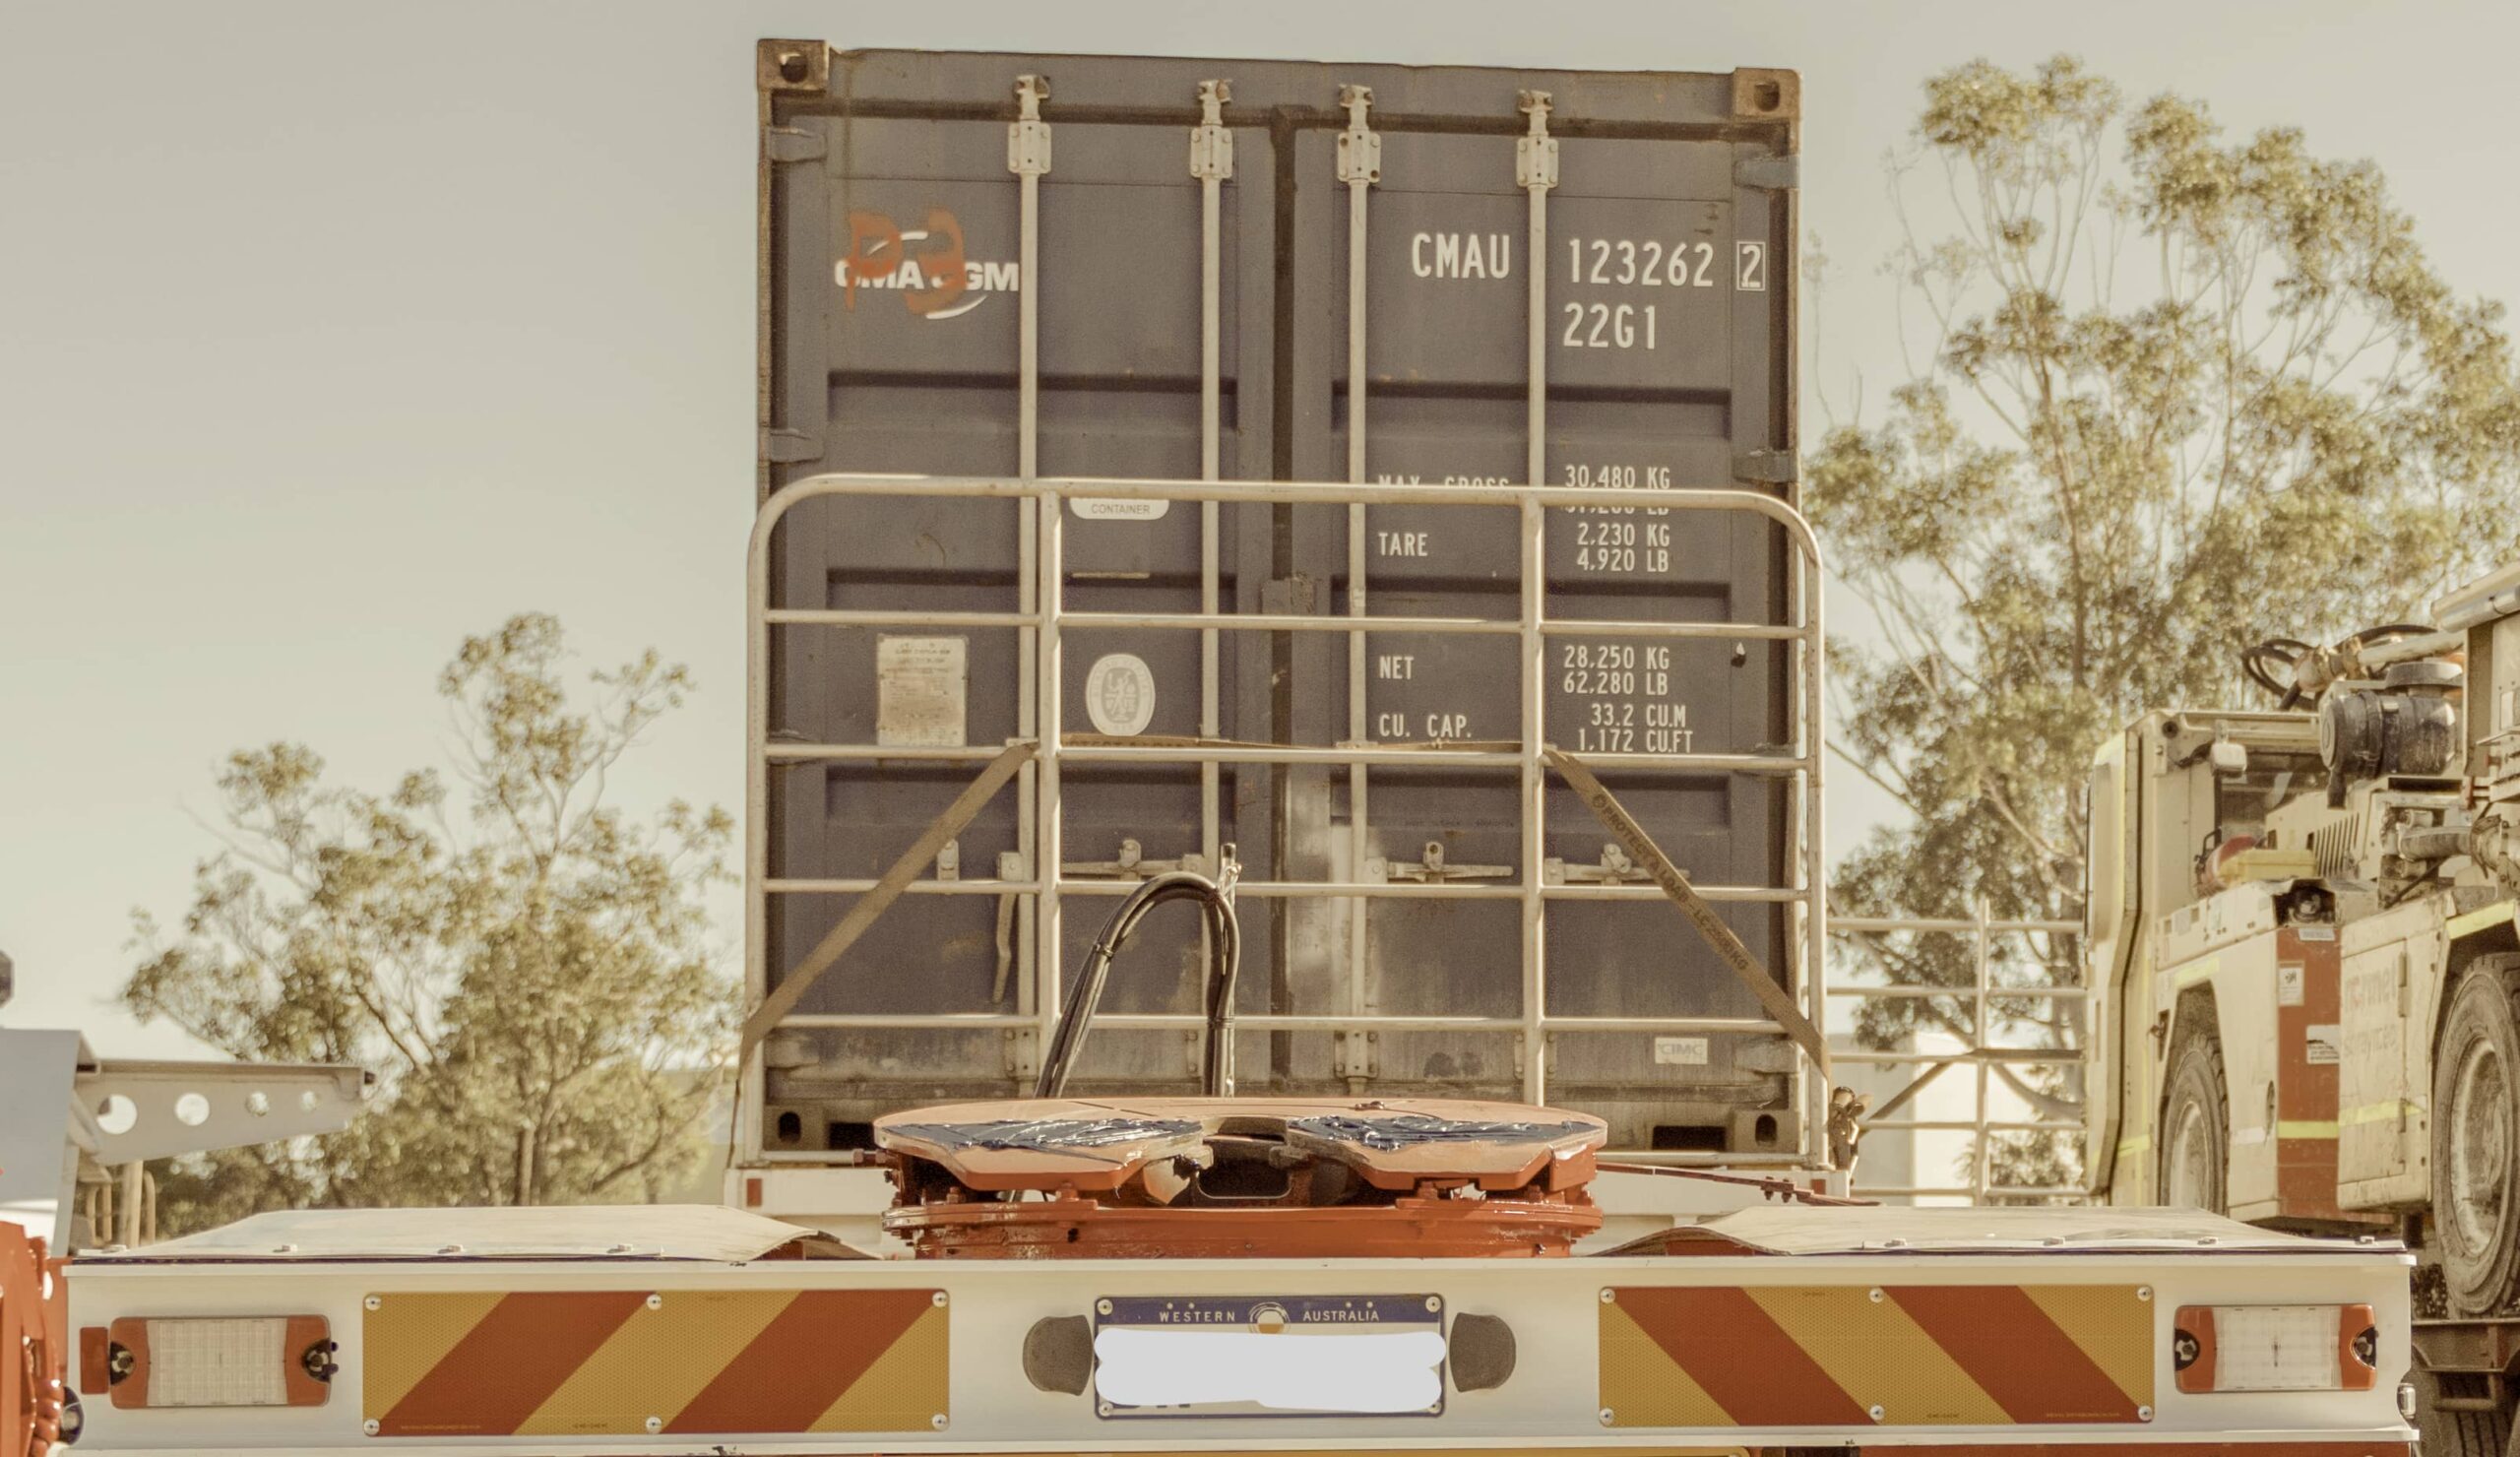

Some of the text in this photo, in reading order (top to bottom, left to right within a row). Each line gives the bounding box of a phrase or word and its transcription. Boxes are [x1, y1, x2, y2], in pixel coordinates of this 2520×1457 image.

[1412, 232, 1763, 288] CMAU 123262 2
[930, 261, 1020, 291] GM
[1563, 302, 1656, 349] 22G1
[1647, 467, 1670, 489] KG
[1091, 503, 1151, 514] CONTAINER
[1379, 533, 1428, 557] TARE
[1577, 522, 1670, 547] 2,230 KG
[1577, 547, 1669, 573] 4,920 LB
[1379, 656, 1415, 680] NET
[1563, 645, 1670, 670] 28,250 KG
[1563, 670, 1669, 695] 62,280 LB
[1379, 715, 1472, 738] CU. CAP.
[1591, 703, 1686, 728] 33.2 CU.M
[1579, 728, 1693, 753] 1,172 CU.FT
[1159, 1310, 1381, 1323] WESTERN AUSTRALIA
